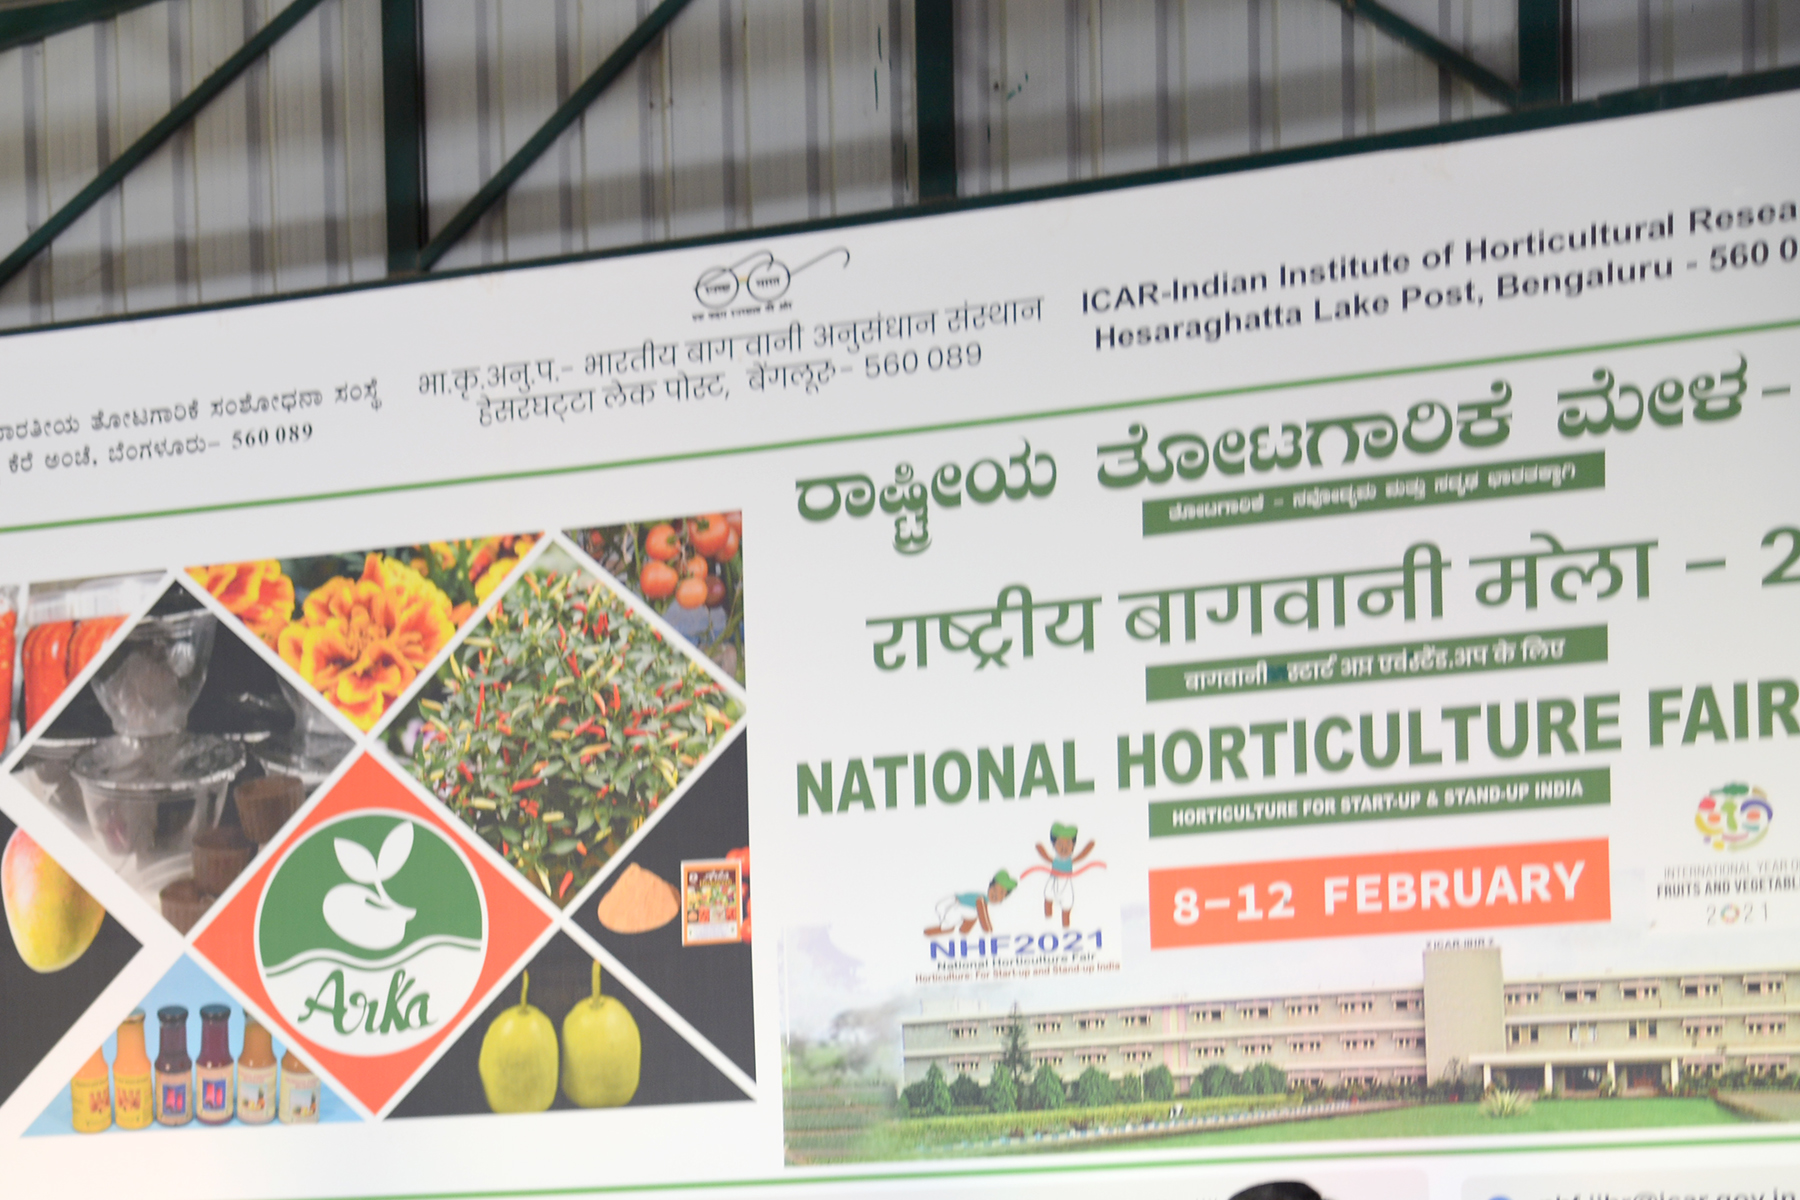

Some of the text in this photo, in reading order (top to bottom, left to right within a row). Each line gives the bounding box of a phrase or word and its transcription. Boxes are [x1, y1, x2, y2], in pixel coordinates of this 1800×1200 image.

[1082, 271, 1267, 315] ICAR-Indian
[1280, 249, 1410, 288] Institute
[1422, 241, 1454, 270] of
[1465, 210, 1674, 265] Horticultural
[1095, 304, 1302, 351] Hesaraghatta
[1314, 291, 1390, 323] Lake
[1402, 279, 1484, 312] Post,
[1498, 258, 1673, 300] Bengaluru
[1709, 238, 1769, 272] 560
[584, 337, 679, 377] भारतीय
[813, 311, 938, 354] अनुसंधान
[945, 295, 1044, 332] संस्थान
[91, 398, 199, 432] ತೋಟಗಾರಿಕೆ
[210, 388, 323, 419] ಸಂಶೋಧನಾ
[335, 377, 382, 413] ಸಂಸ್ಥೆ
[602, 376, 657, 408] लेक
[663, 369, 730, 402] पोस्ट,
[864, 350, 918, 380] 560
[927, 342, 982, 371] 089
[9, 451, 34, 474] ಕೆರೆ
[232, 428, 269, 451] 560
[276, 421, 314, 447] 089
[795, 436, 1057, 557] ರಾಷ್ಟ್ರೀಯ
[1097, 379, 1513, 489] ತೋಟಗಾರಿಕೆ
[1557, 351, 1748, 438] ಮೇಳ
[866, 584, 1102, 671] राष्ट्रीय
[1118, 542, 1451, 645] बागवानी
[1469, 530, 1658, 611] मेला
[796, 677, 1800, 816] NATIONAL HORTICULTURE FAIR
[1171, 778, 1584, 828] HORTICULTURE FOR START-UP & STAND-UP INDIA
[1323, 861, 1588, 916] FEBRUARY
[1657, 882, 1701, 899] FRUITS
[1705, 880, 1730, 896] AND
[930, 928, 1103, 961] NHF2021
[937, 951, 1096, 971] National Horticulture Fair
[297, 968, 438, 1035] Arka
